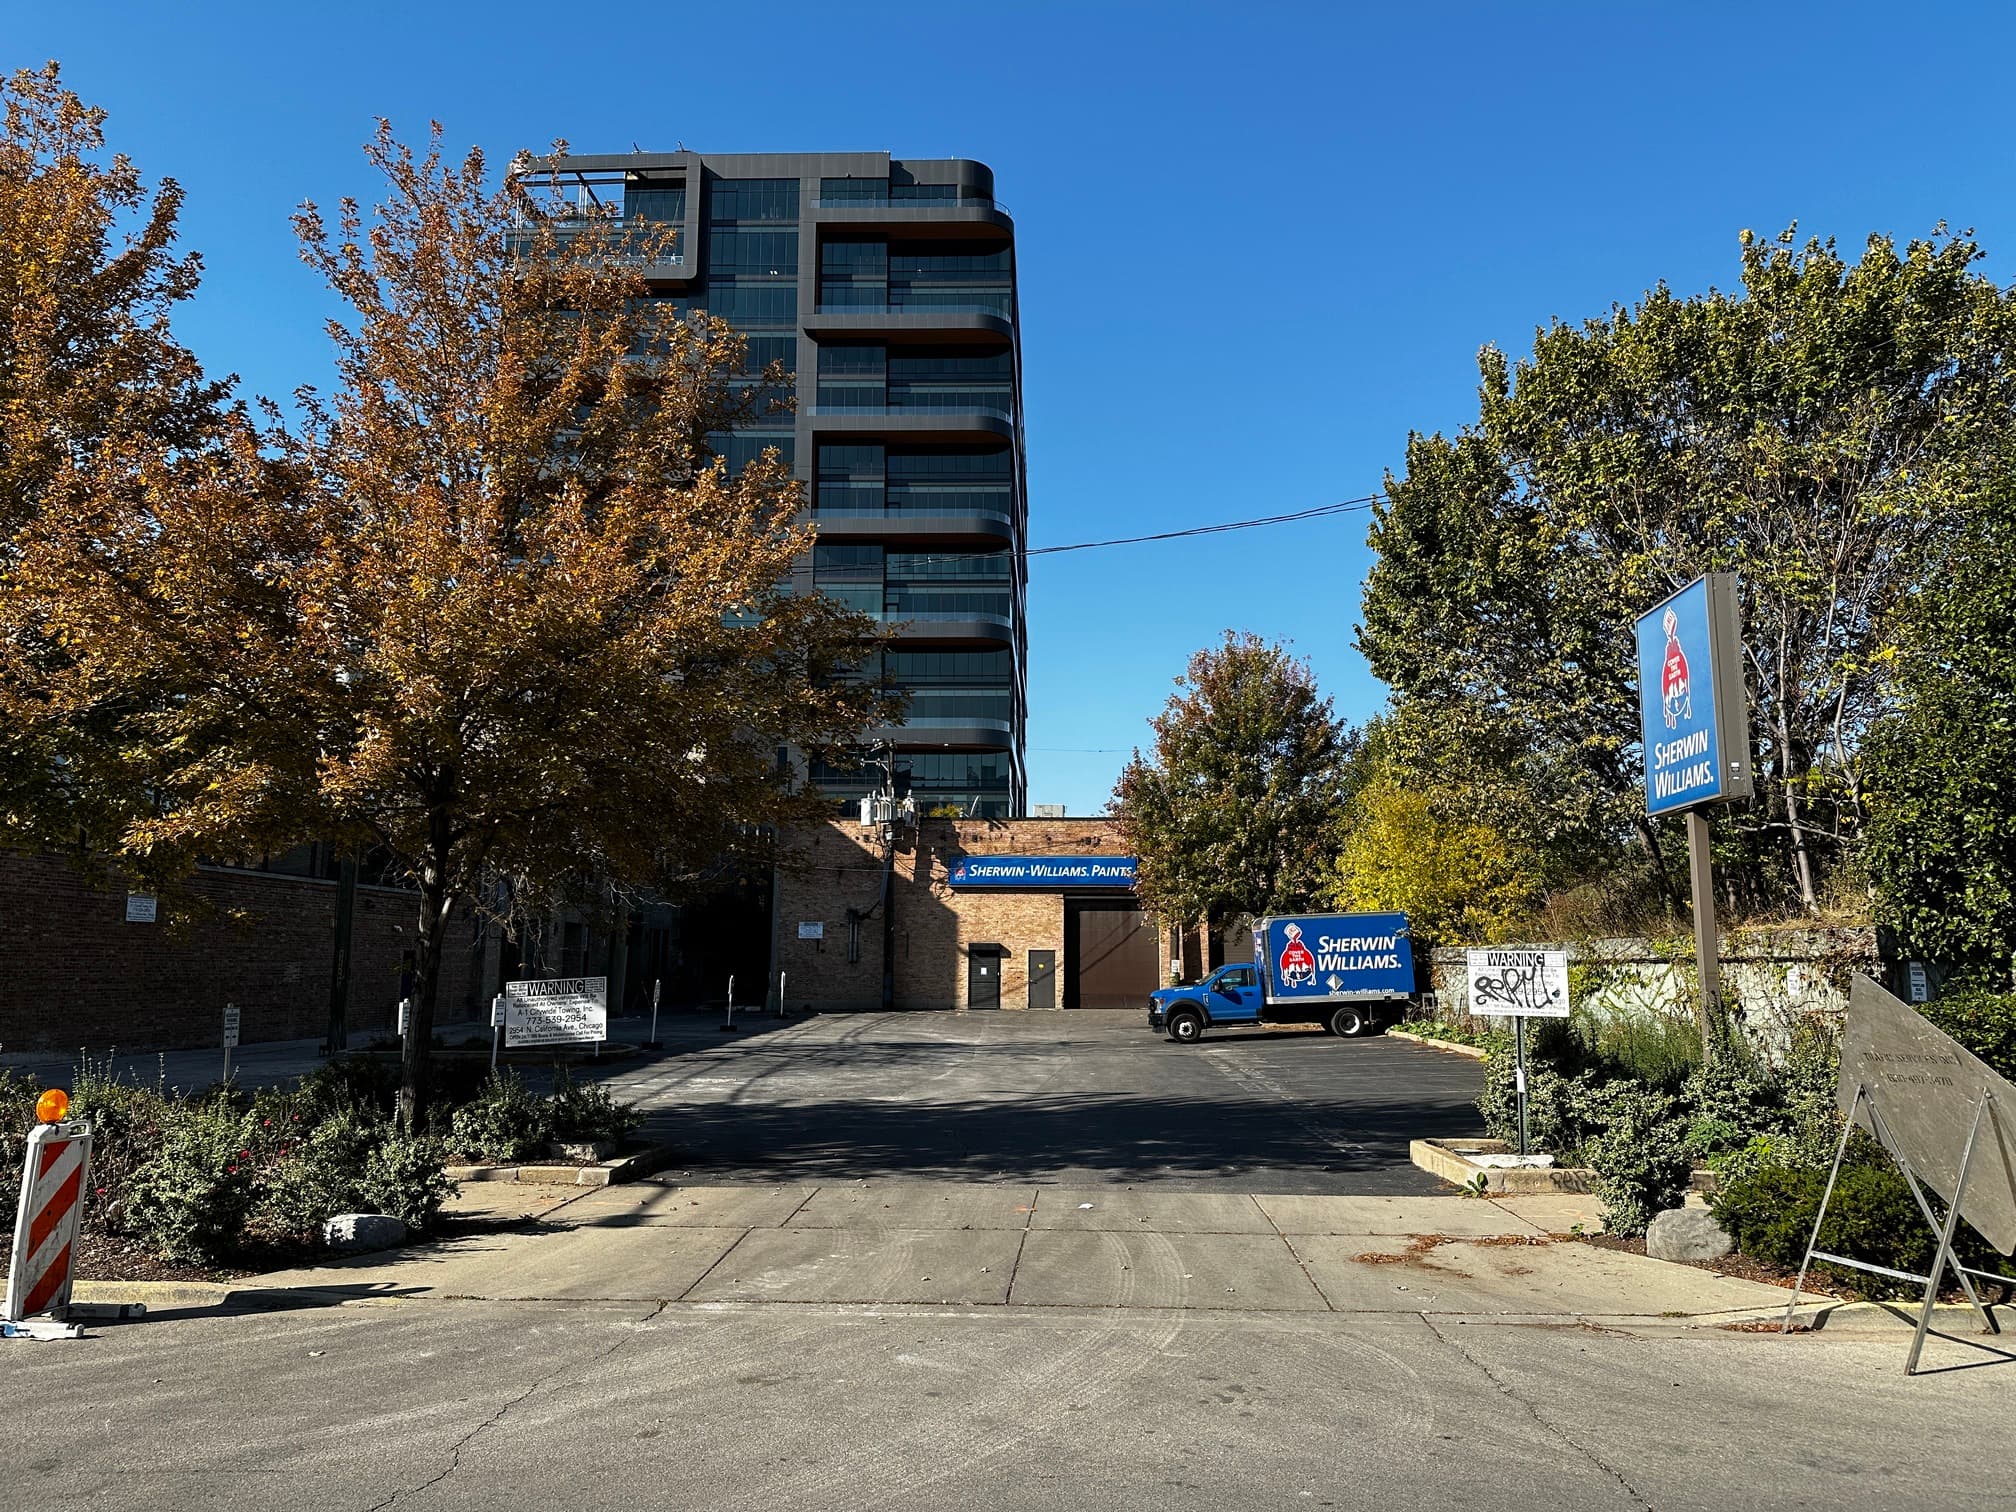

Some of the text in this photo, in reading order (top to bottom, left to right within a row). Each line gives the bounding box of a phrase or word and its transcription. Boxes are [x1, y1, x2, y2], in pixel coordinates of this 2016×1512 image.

[1655, 729, 1708, 769] SHERWIN
[1091, 864, 1133, 877] PAINTS
[1318, 936, 1396, 953] SHERWIN
[1489, 953, 1544, 966] WARNING
[529, 980, 584, 996] WARNING
[1329, 988, 1395, 996] sherwin-williams.com
[529, 1008, 557, 1016] Citywide
[526, 1014, 587, 1025] 773-539-2954
